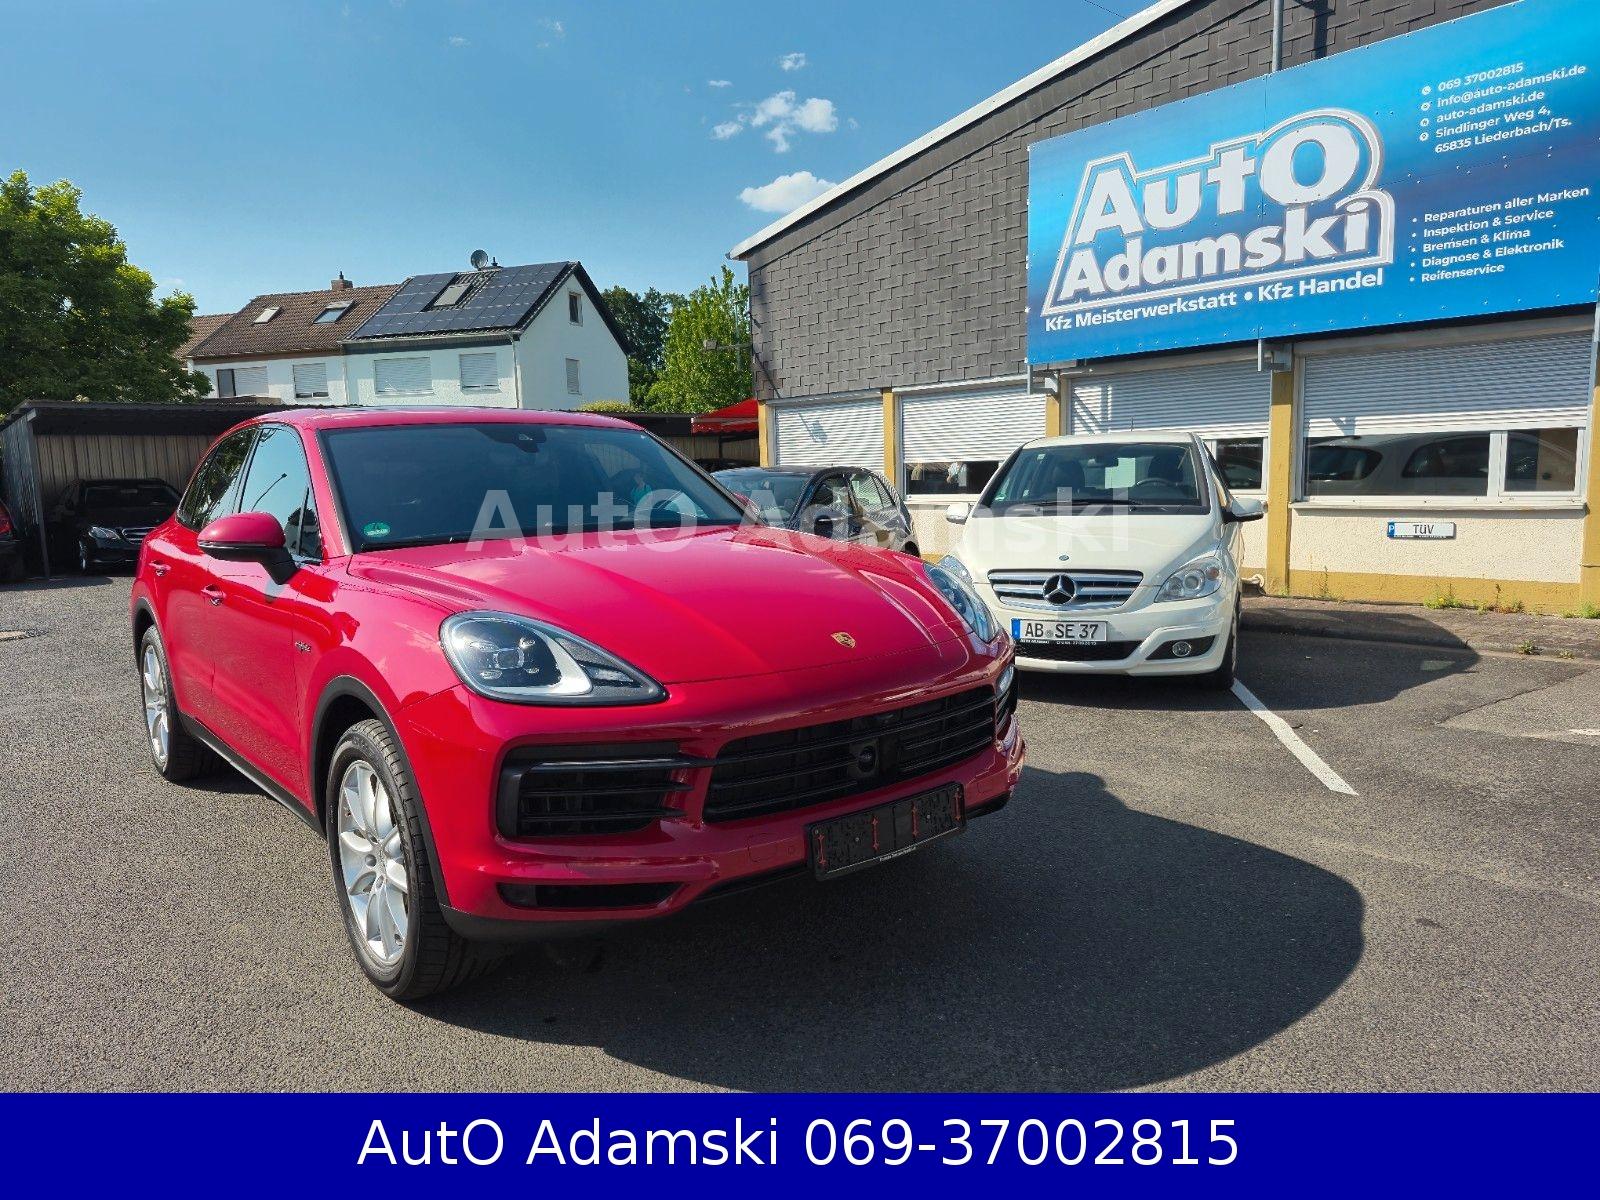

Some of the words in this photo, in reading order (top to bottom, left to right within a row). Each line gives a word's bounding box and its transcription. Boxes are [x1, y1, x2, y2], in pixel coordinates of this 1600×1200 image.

[1437, 65, 1586, 108] info@auto-adamski.de
[1438, 77, 1461, 92] 069
[1464, 62, 1524, 86] 37002815
[1435, 116, 1500, 138] Sindlinger
[1504, 109, 1534, 122] Weg
[1538, 105, 1551, 116] 4,
[1436, 91, 1545, 123] auto-adamski.de
[1434, 138, 1472, 154] 65835
[1474, 117, 1572, 145] Liederbach/Ts.
[1424, 202, 1501, 223] Reparaturen
[1504, 197, 1533, 210] aller
[1537, 186, 1590, 204] Marken
[1423, 217, 1489, 238] Inspektion
[1492, 217, 1502, 227] &
[1504, 209, 1554, 225] Service
[1059, 201, 1369, 301] Adamski
[1422, 251, 1480, 268] Diagnose
[1482, 249, 1492, 259] &
[1495, 238, 1564, 258] Elektronik
[1423, 236, 1477, 253] Bremsen
[1481, 234, 1490, 244] &
[1493, 228, 1531, 242] Klima
[1421, 263, 1505, 283] Reifenservice
[1045, 316, 1072, 331] Kfz
[1075, 291, 1237, 327] Meisterwerkstatt
[1258, 281, 1294, 302] Kfz
[1299, 267, 1383, 295] Handel
[1025, 622, 1044, 638] AB
[1055, 623, 1075, 639] SE
[1079, 623, 1098, 639] 37
